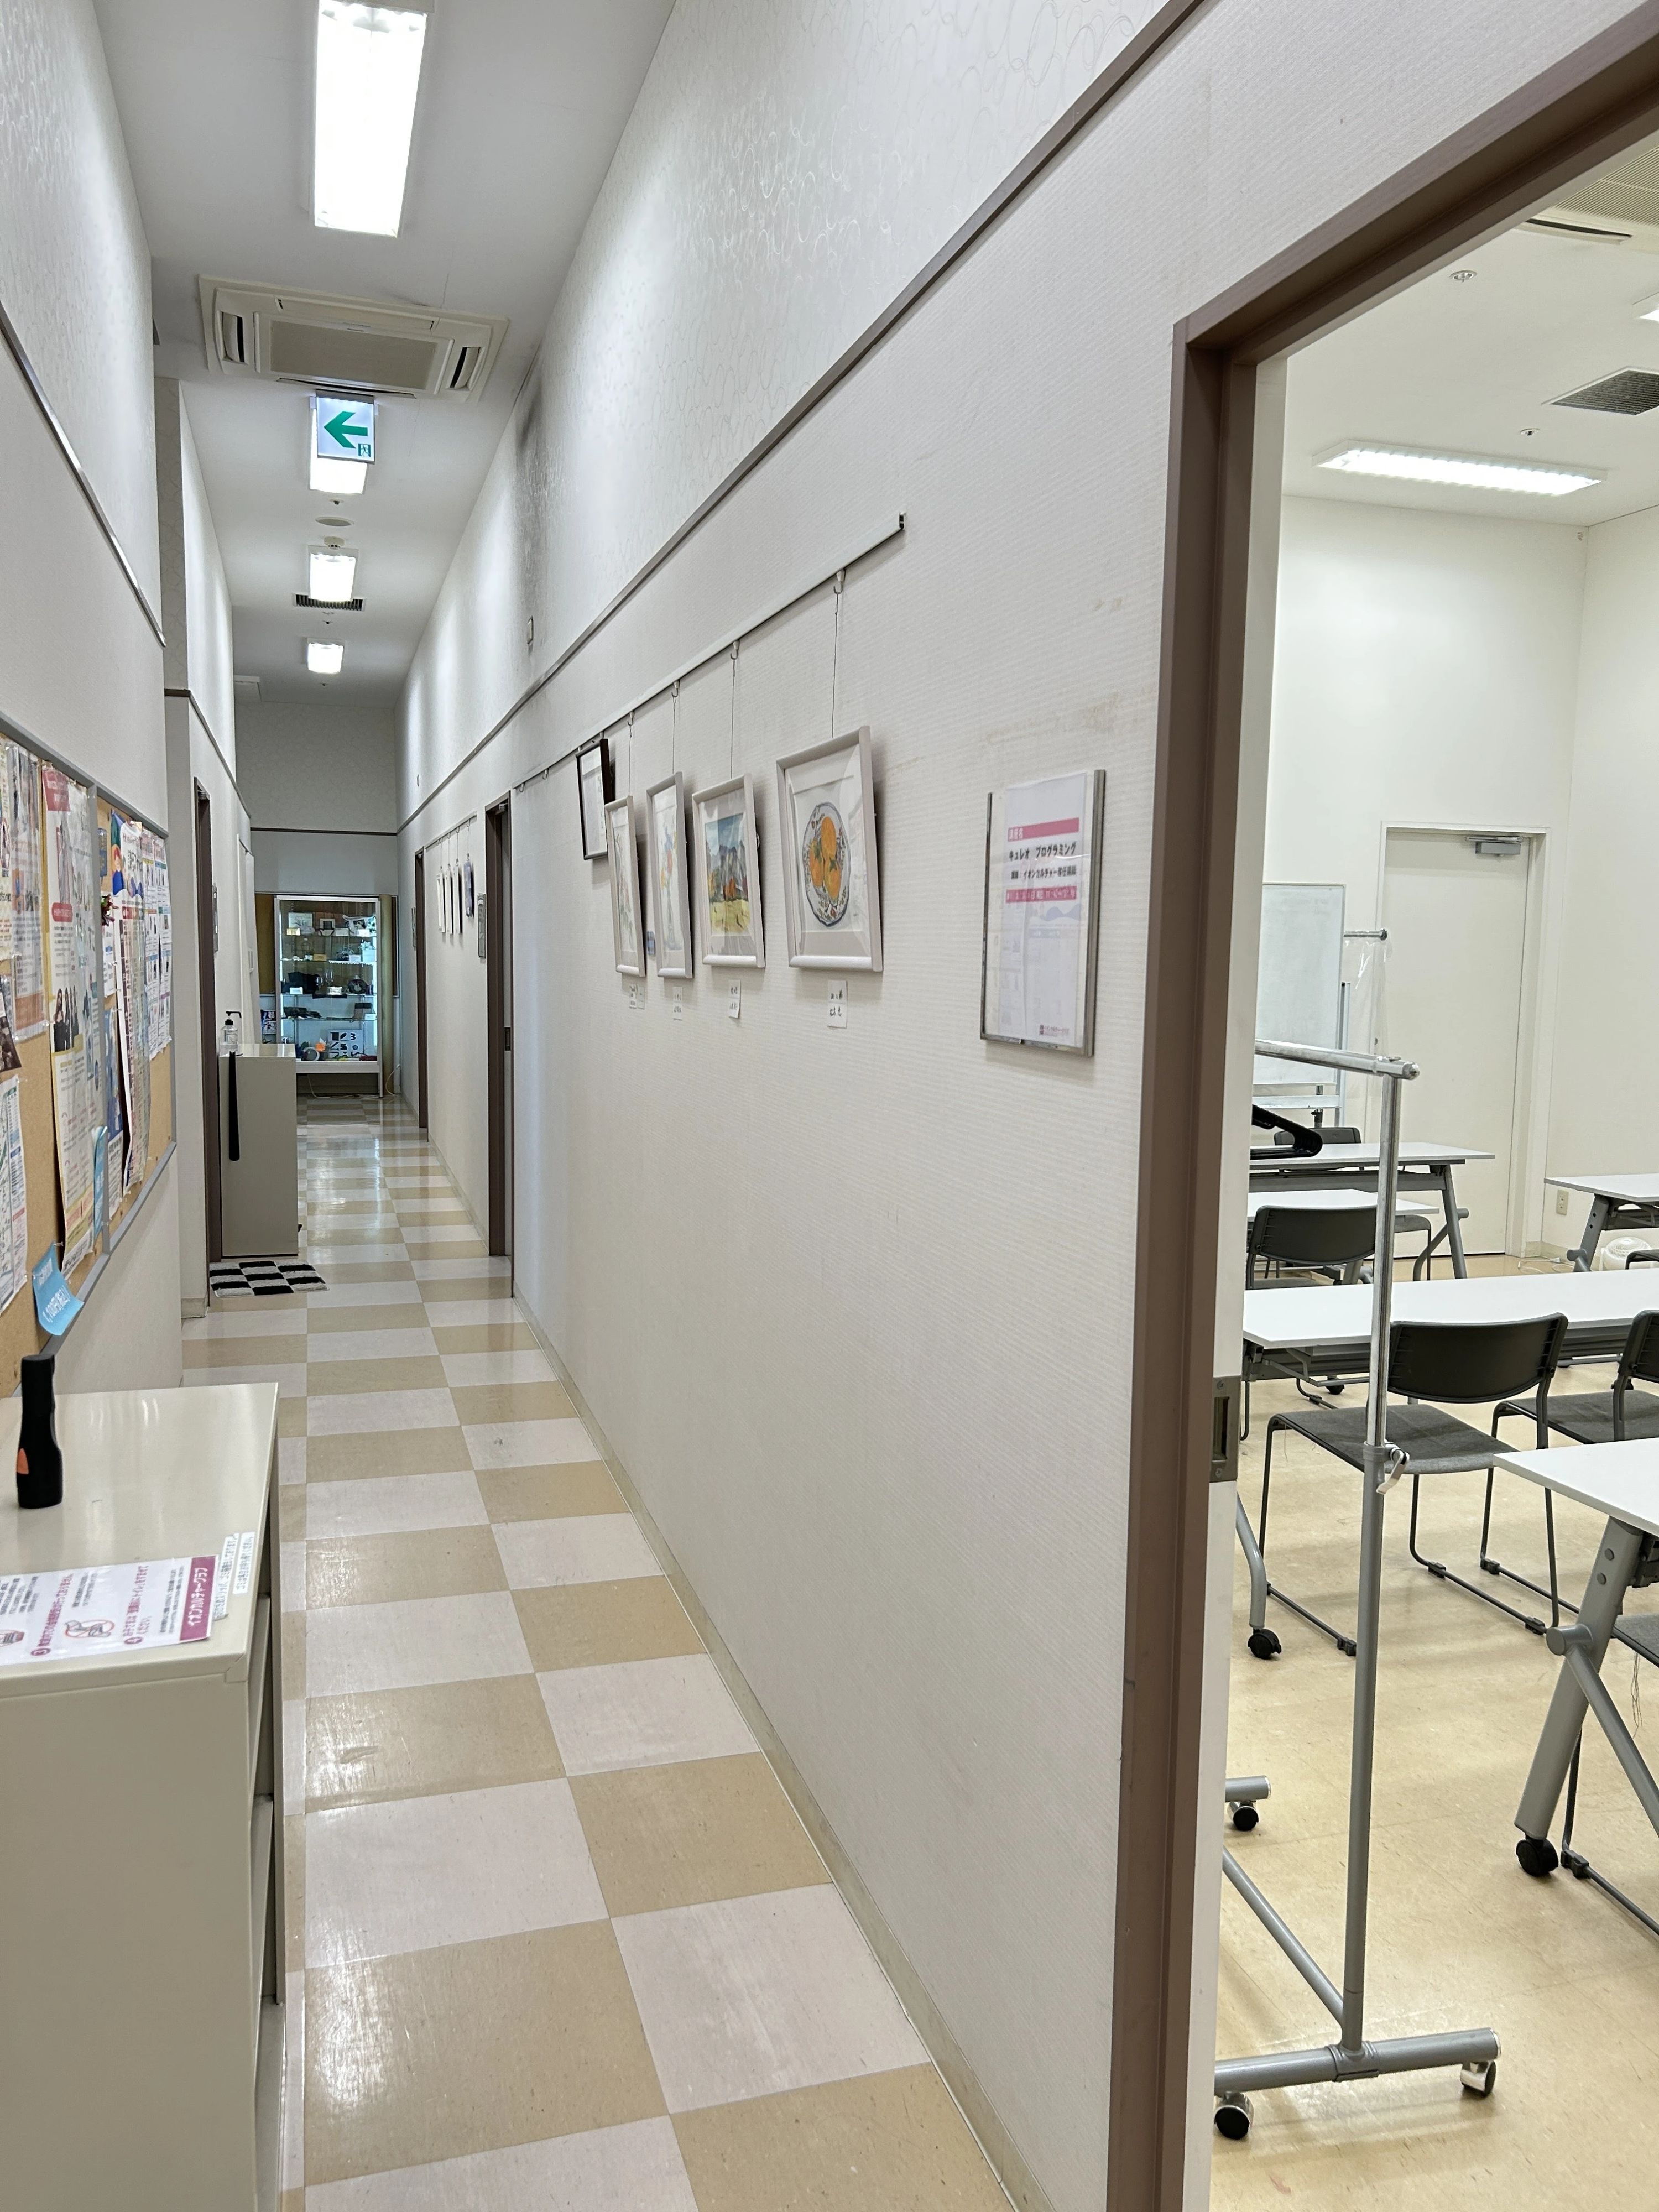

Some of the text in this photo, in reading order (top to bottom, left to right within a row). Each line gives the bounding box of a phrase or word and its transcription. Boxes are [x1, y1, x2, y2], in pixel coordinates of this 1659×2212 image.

[1009, 841, 1077, 861] キュレオ プログラミング
[187, 1567, 208, 1627] イオンカルチャークラブ
